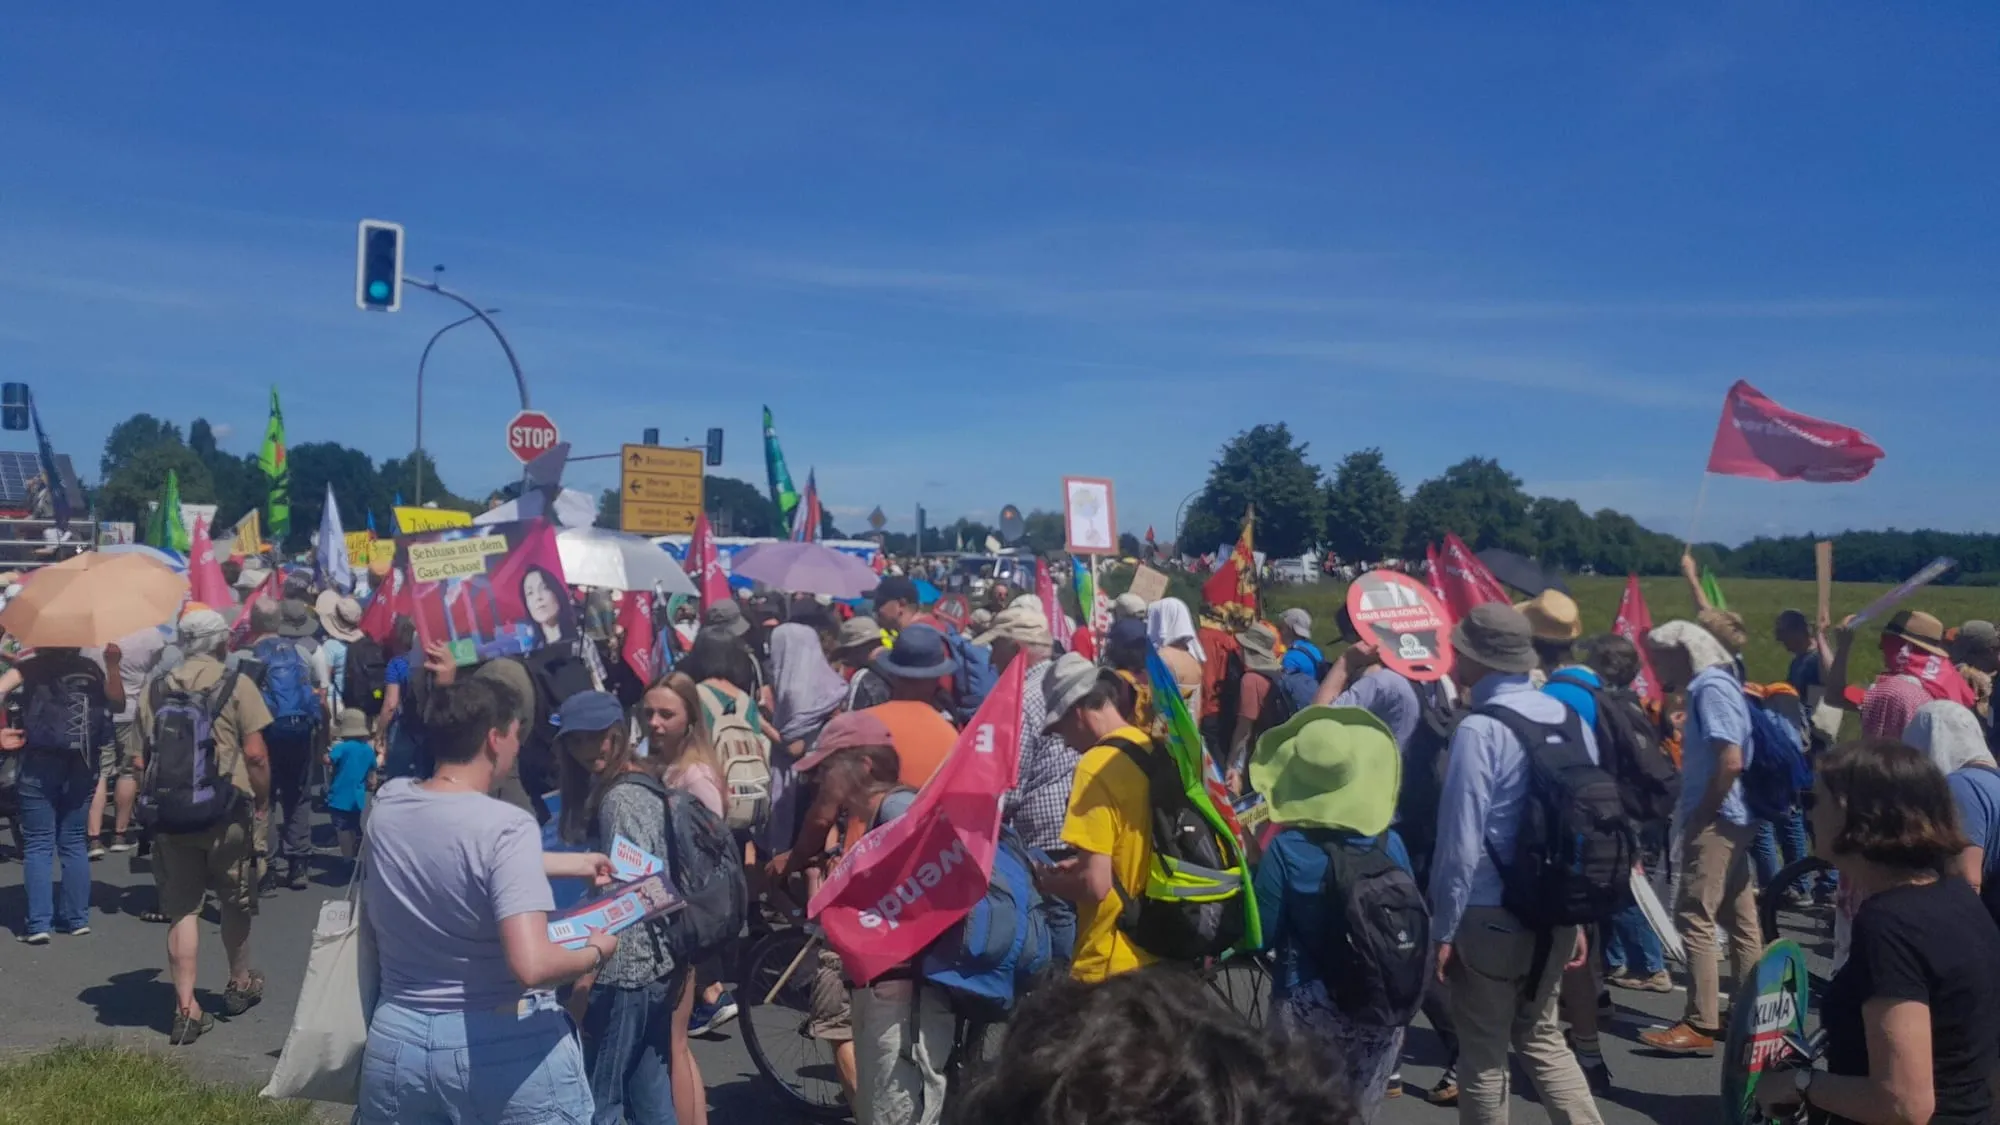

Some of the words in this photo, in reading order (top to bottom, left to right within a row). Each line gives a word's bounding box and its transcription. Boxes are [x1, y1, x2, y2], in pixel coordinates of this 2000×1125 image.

[511, 426, 554, 449] STOP
[412, 543, 456, 560] Schluss
[456, 541, 478, 554] mit
[479, 539, 504, 552] dem
[1752, 998, 1790, 1028] KLIMA
